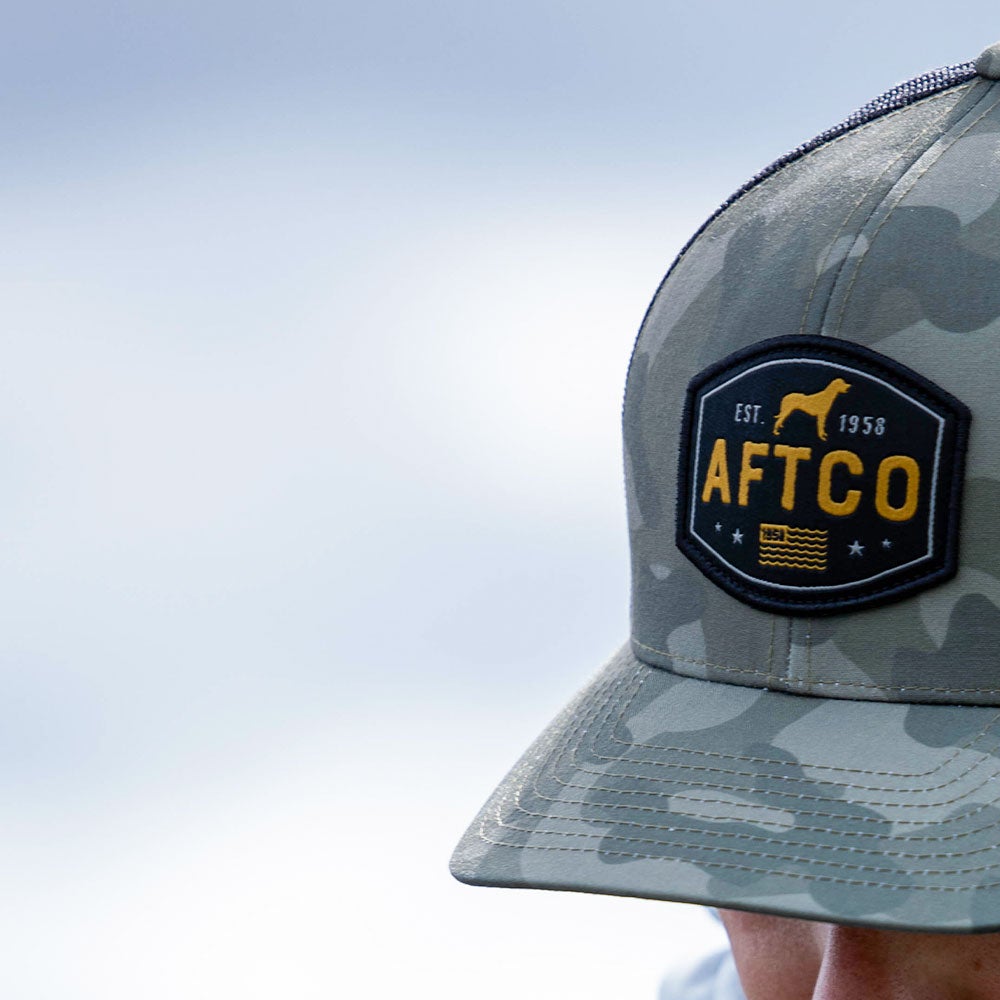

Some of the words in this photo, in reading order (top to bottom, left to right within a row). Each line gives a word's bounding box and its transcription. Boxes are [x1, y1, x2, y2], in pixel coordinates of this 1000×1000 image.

[734, 403, 765, 425] EST.
[839, 413, 886, 436] 1958
[701, 438, 920, 521] AFTCO
